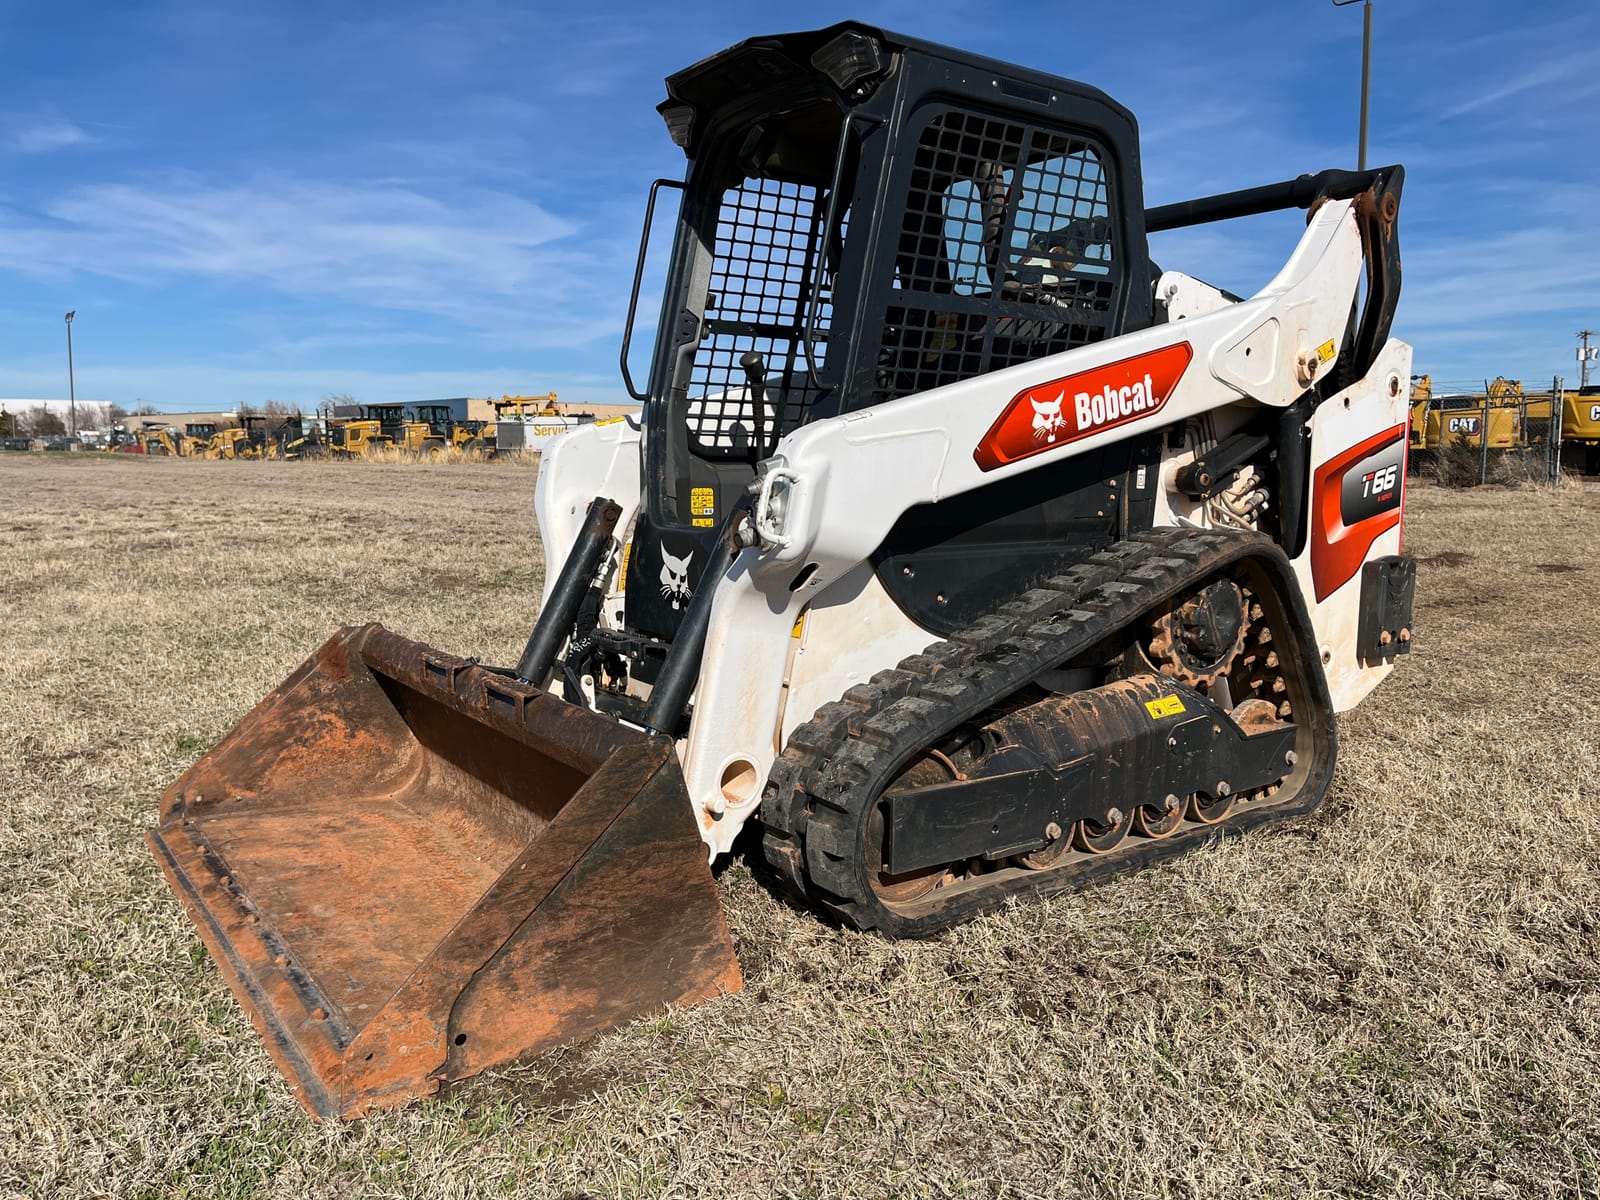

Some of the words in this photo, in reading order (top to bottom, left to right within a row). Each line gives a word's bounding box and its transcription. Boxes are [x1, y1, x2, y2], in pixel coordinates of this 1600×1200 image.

[1074, 373, 1154, 431] Bobcat
[1449, 417, 1476, 432] CAT
[1362, 464, 1398, 498] T66
